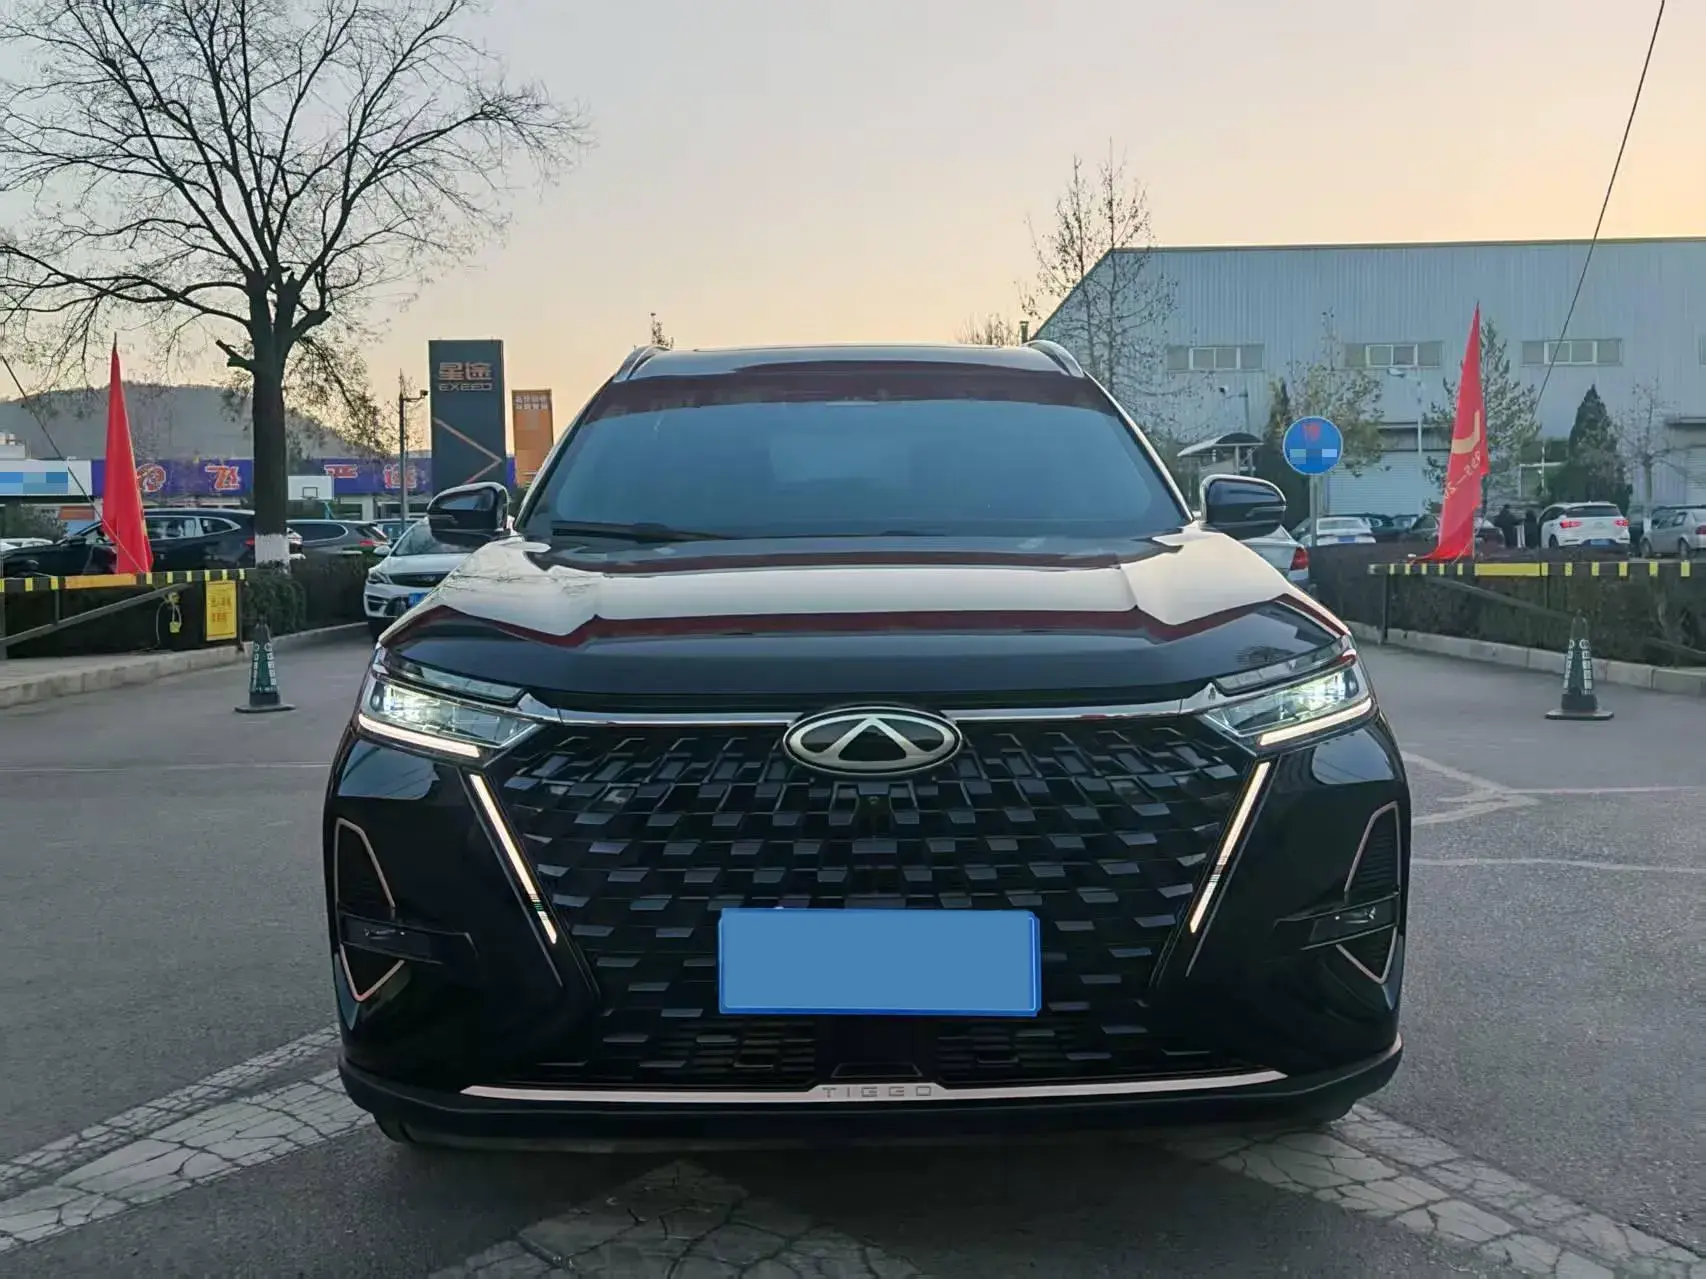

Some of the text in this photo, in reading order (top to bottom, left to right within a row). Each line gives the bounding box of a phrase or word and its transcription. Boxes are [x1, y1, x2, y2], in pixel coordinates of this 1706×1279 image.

[438, 362, 492, 381] 星途
[438, 382, 493, 392] EXEED
[822, 1085, 932, 1098] TIGGO
